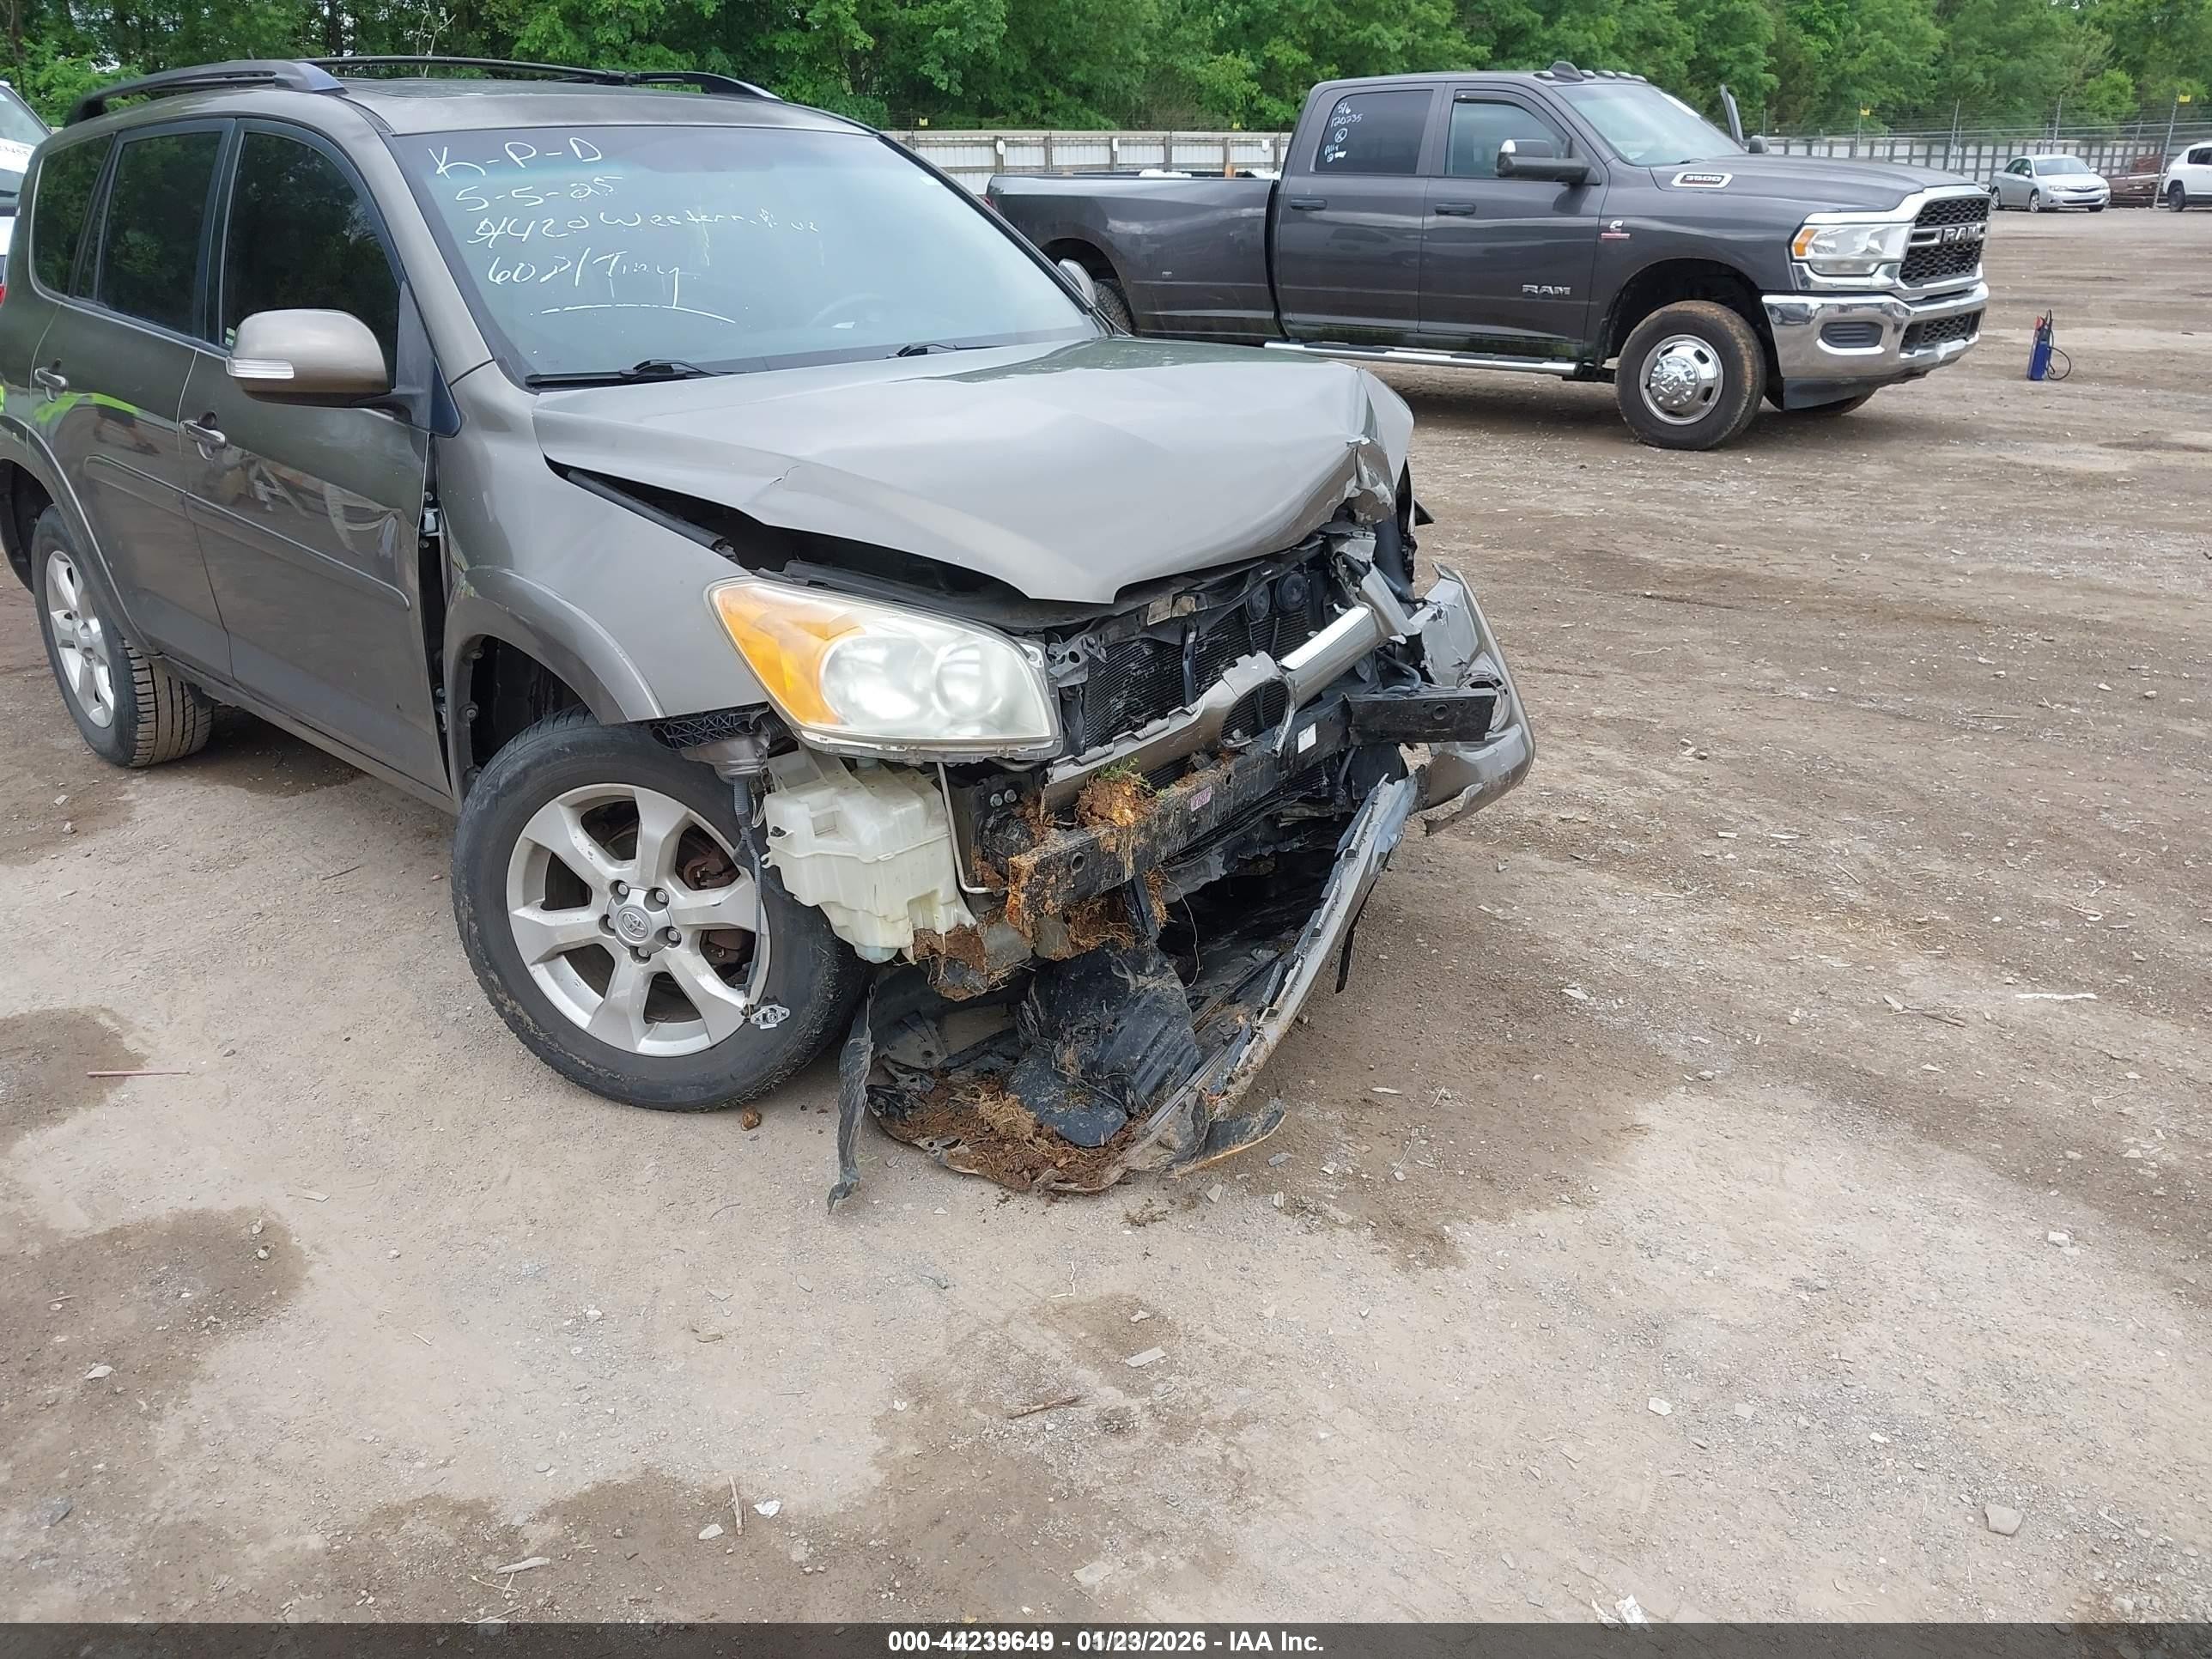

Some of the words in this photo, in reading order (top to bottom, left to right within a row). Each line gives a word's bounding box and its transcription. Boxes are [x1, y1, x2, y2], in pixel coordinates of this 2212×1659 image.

[455, 174, 623, 212] 5-5-25
[1942, 226, 1980, 242] RAM
[1522, 284, 1572, 296] RAM
